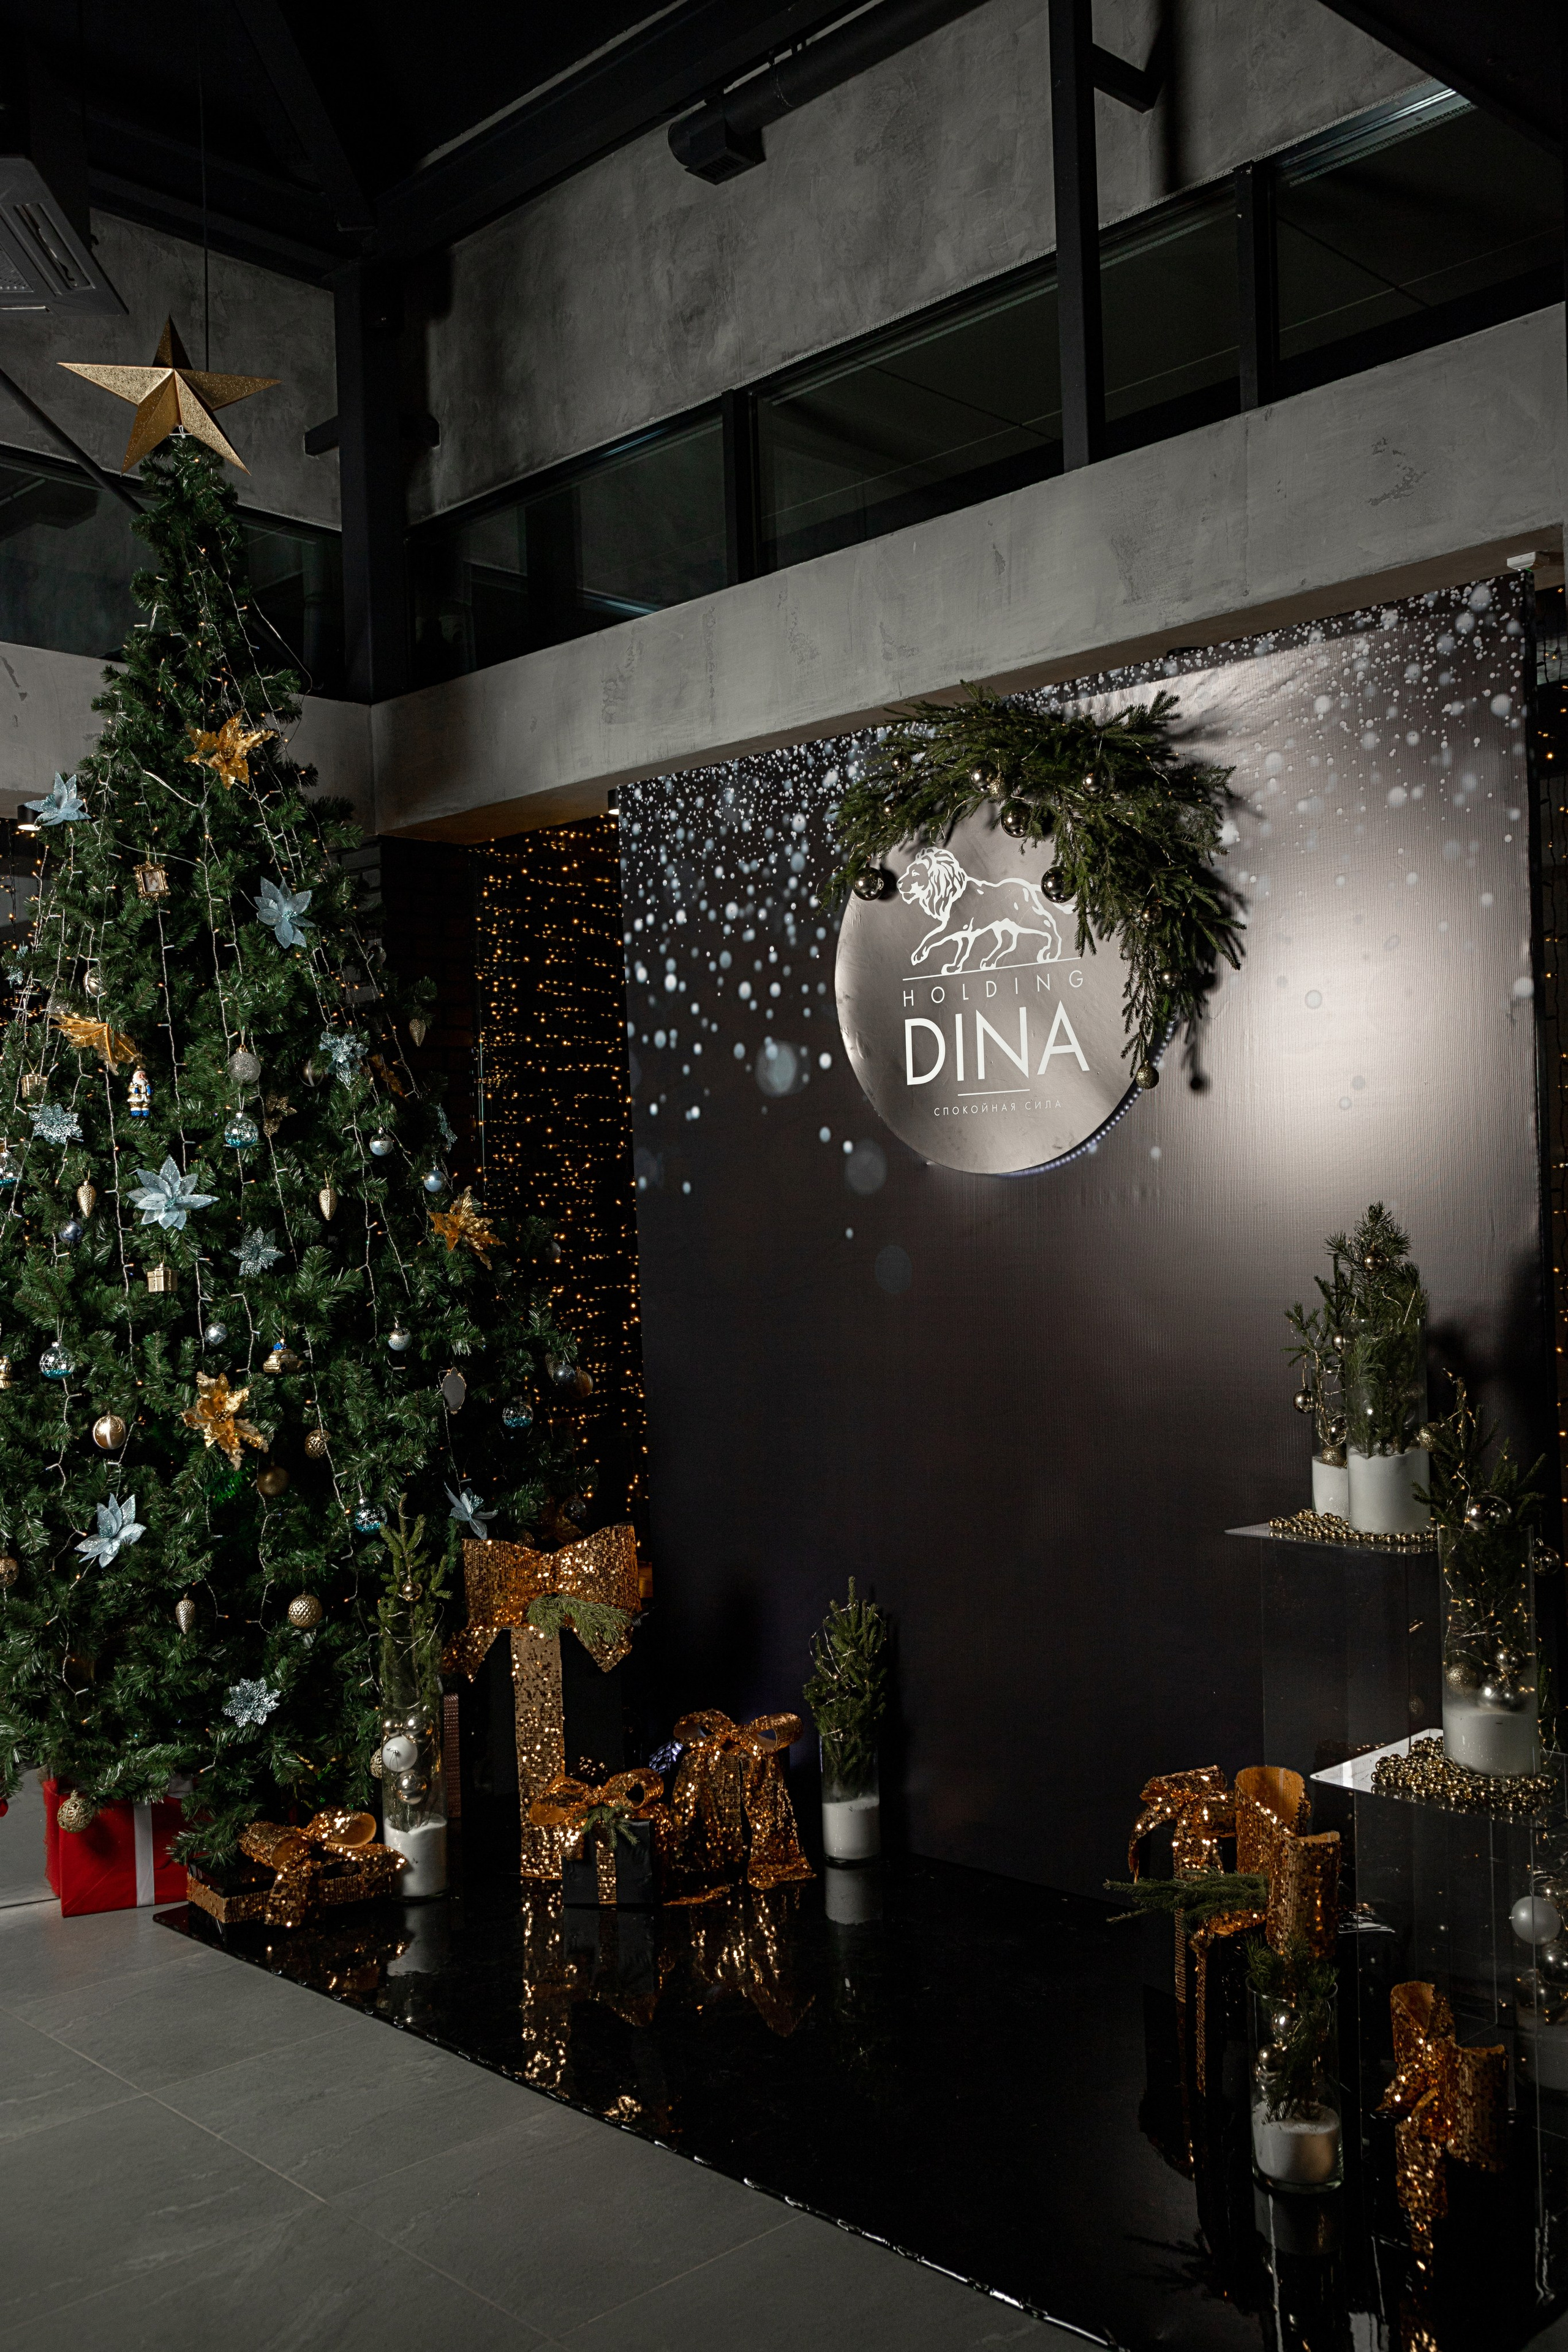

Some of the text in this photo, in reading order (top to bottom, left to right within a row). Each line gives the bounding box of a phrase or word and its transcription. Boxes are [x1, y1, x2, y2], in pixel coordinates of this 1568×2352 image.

[903, 970, 1084, 1007] HOLDING
[905, 1000, 1090, 1085] DINA
[934, 1100, 1061, 1116] СПОКОЙНАЯ СИЛА
